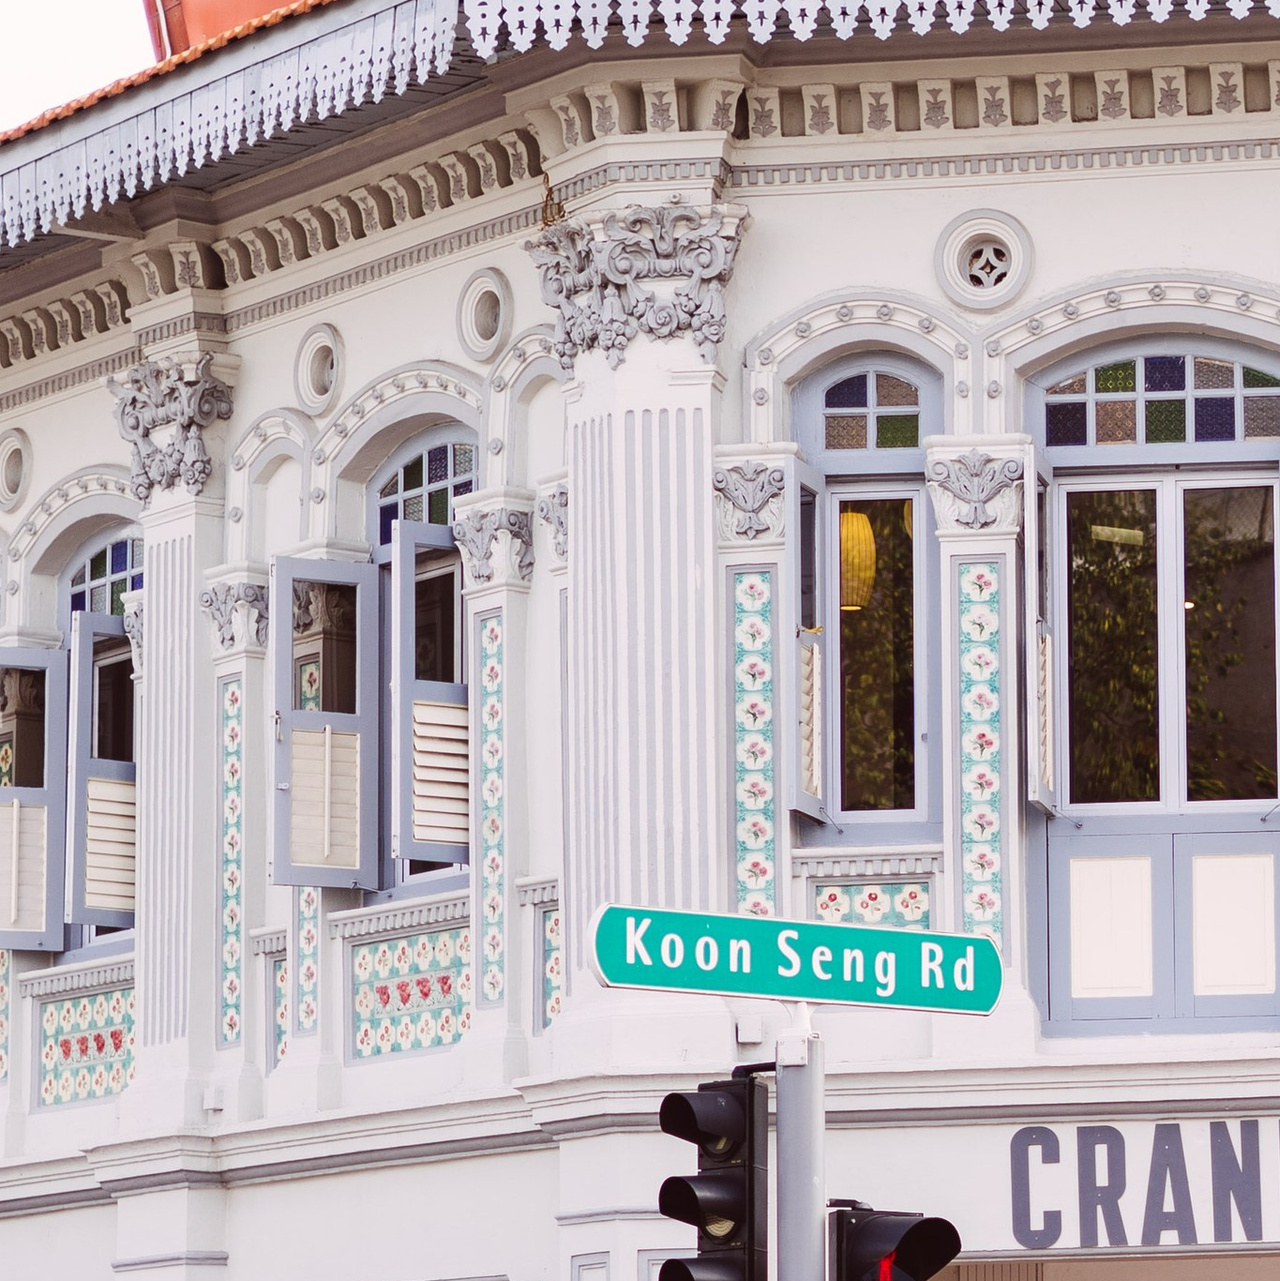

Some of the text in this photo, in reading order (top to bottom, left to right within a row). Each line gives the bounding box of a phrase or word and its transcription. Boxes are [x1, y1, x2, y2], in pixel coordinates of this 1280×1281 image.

[625, 917, 975, 998] Koon Seng Rd
